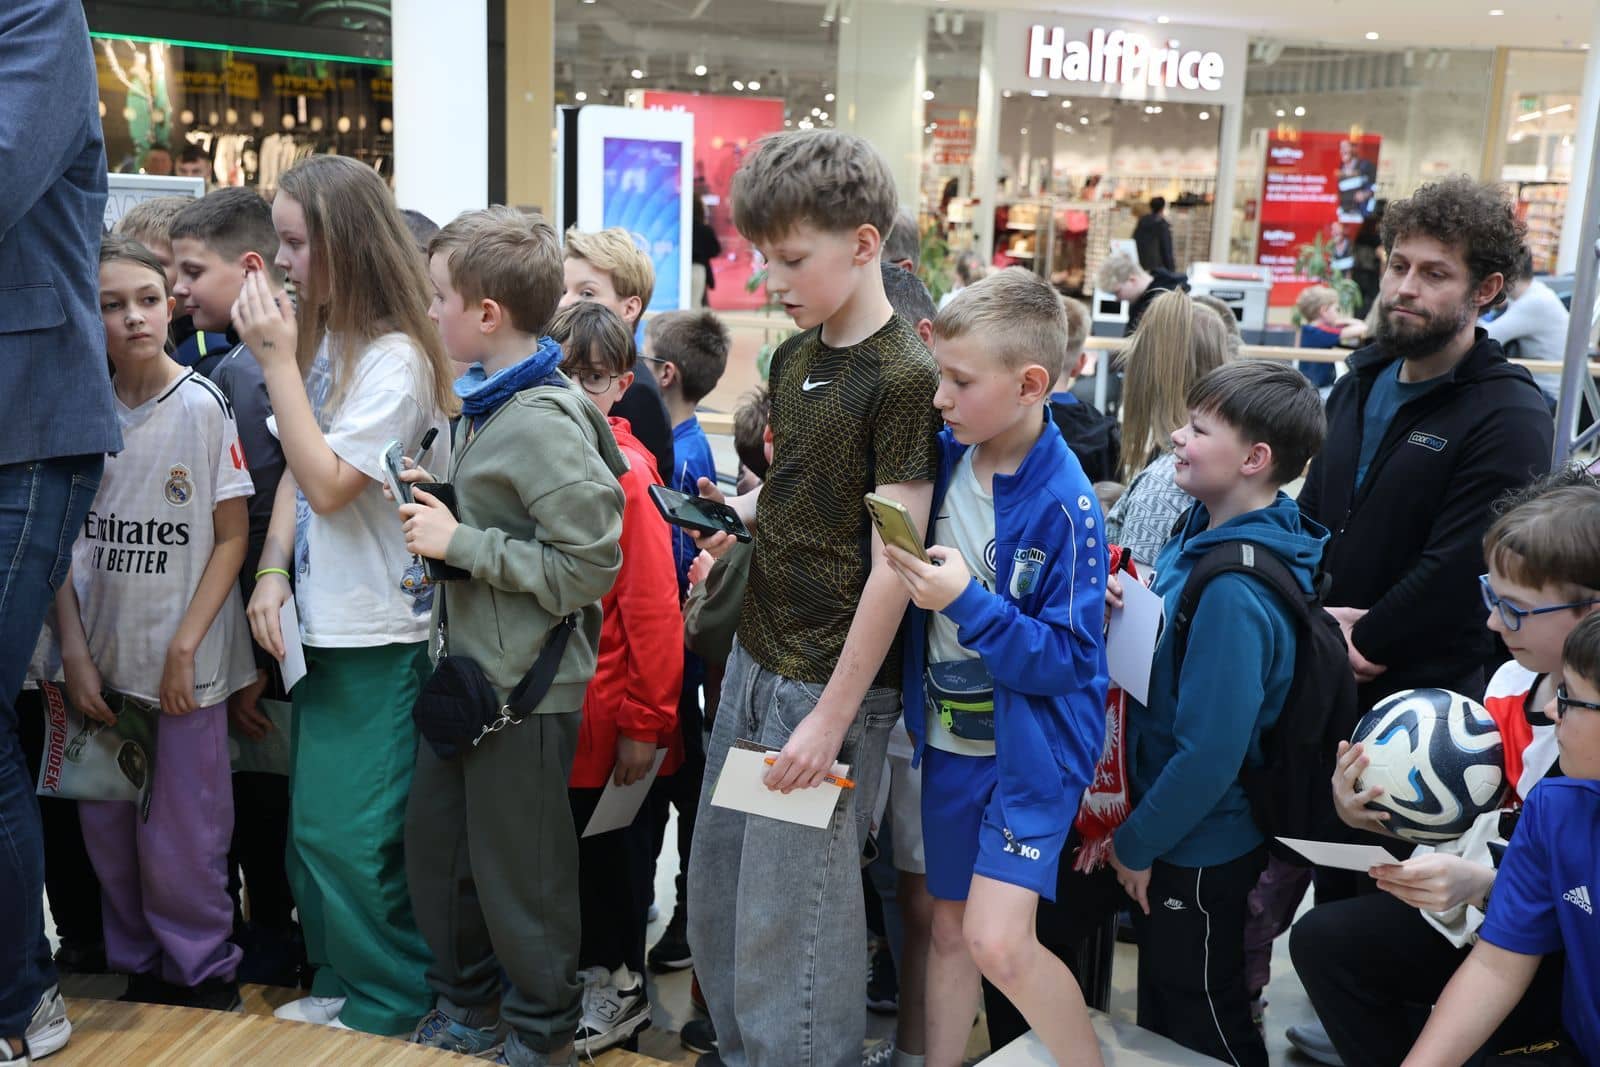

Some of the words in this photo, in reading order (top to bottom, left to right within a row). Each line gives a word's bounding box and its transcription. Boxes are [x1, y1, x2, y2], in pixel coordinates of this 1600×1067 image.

[1028, 24, 1225, 91] HalfPrice
[84, 511, 190, 546] Emirates
[107, 548, 168, 574] BETTER
[43, 730, 68, 791] DUDEK
[1562, 892, 1593, 915] adidas
